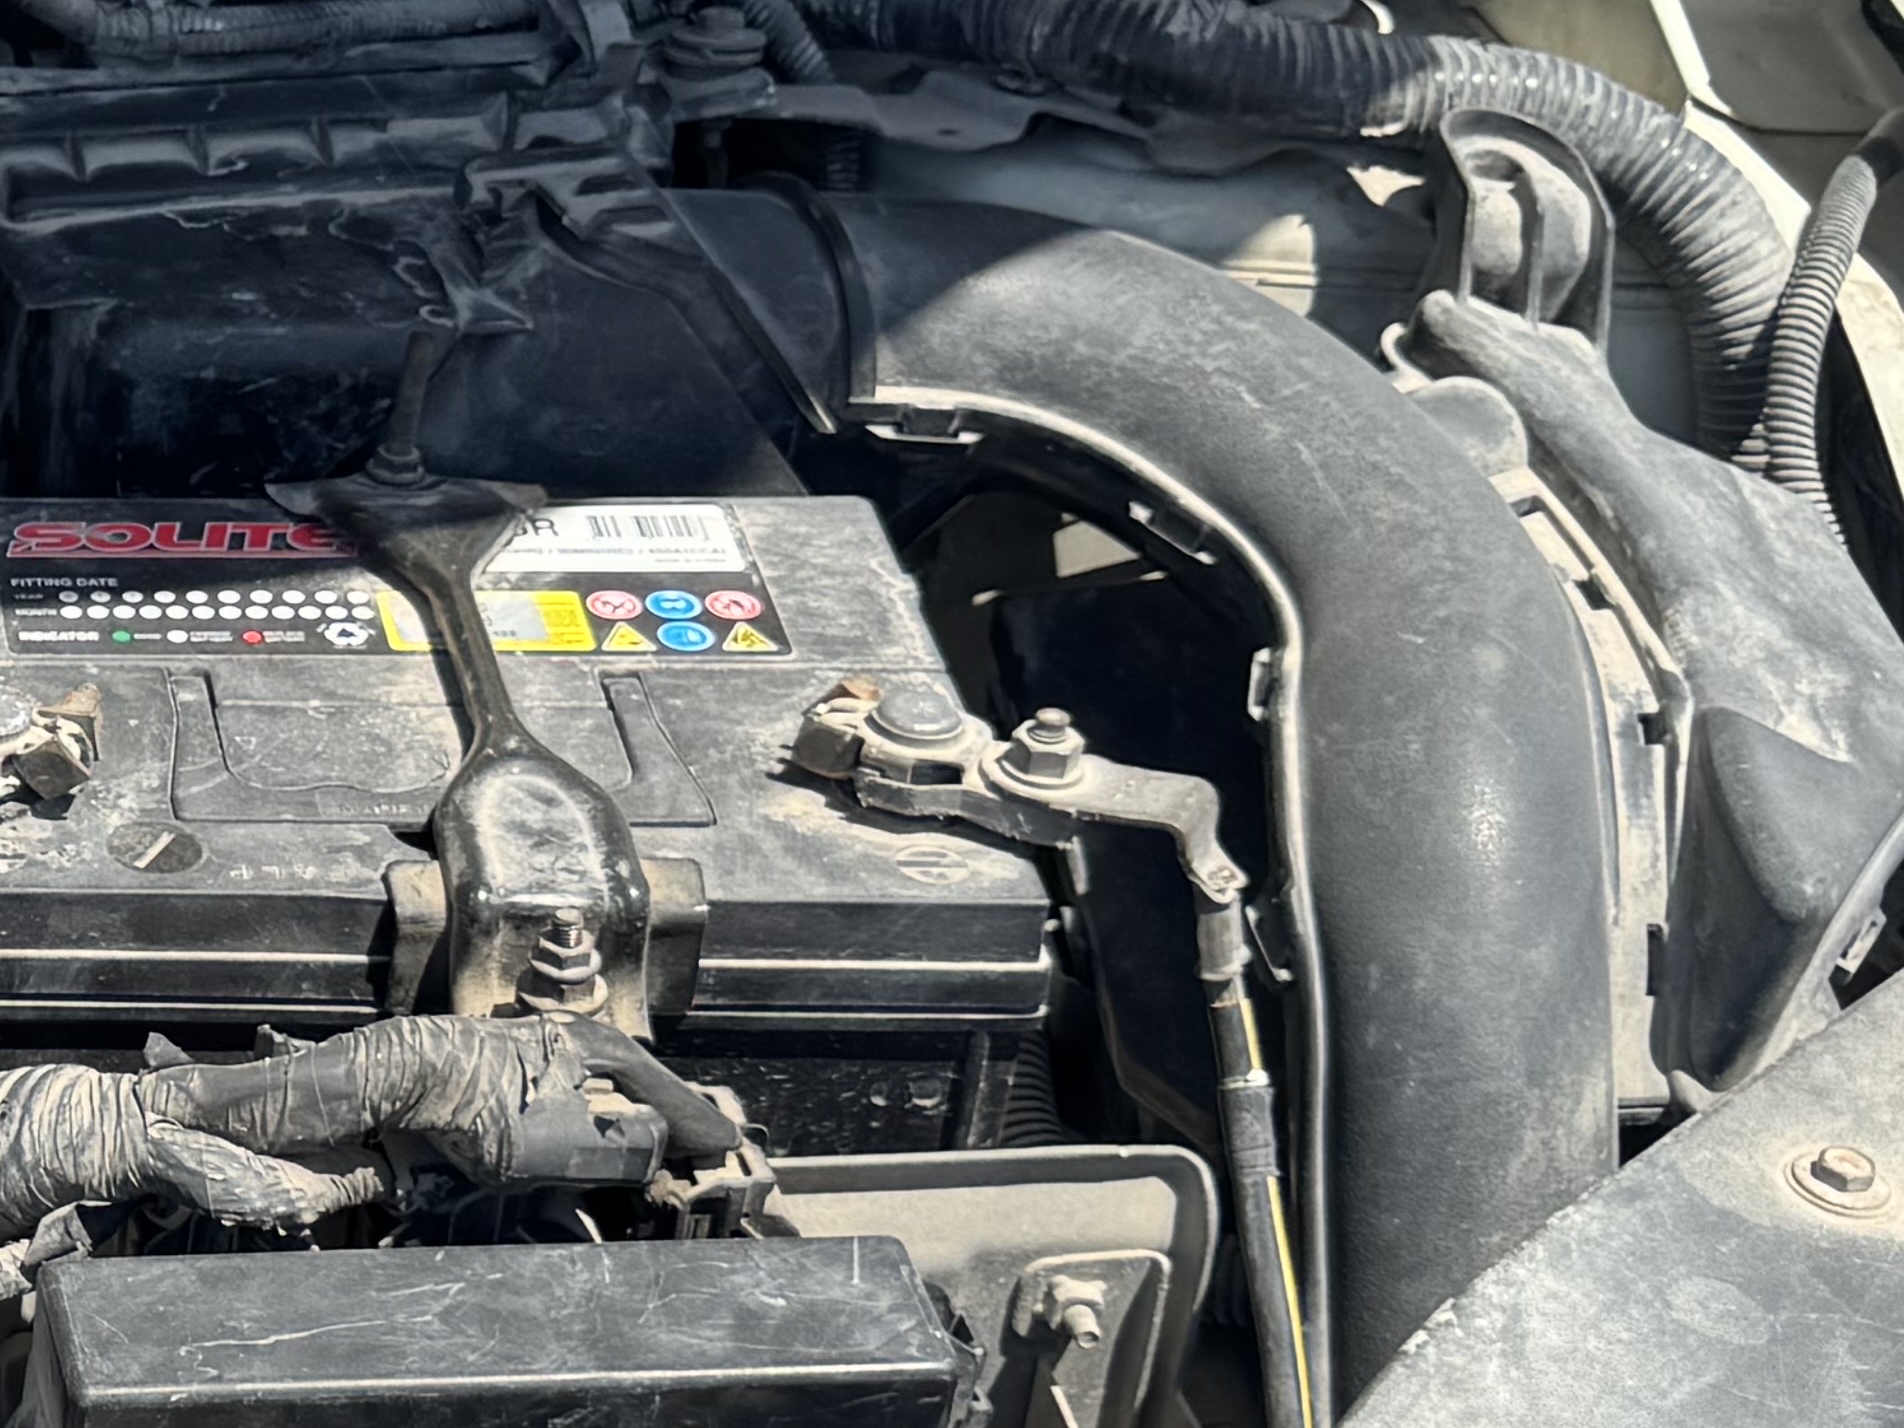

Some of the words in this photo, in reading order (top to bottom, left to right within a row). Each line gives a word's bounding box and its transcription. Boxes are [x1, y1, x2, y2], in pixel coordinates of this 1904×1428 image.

[7, 521, 342, 557] SOLITE
[10, 577, 73, 588] FITTING
[76, 577, 118, 588] DATE
